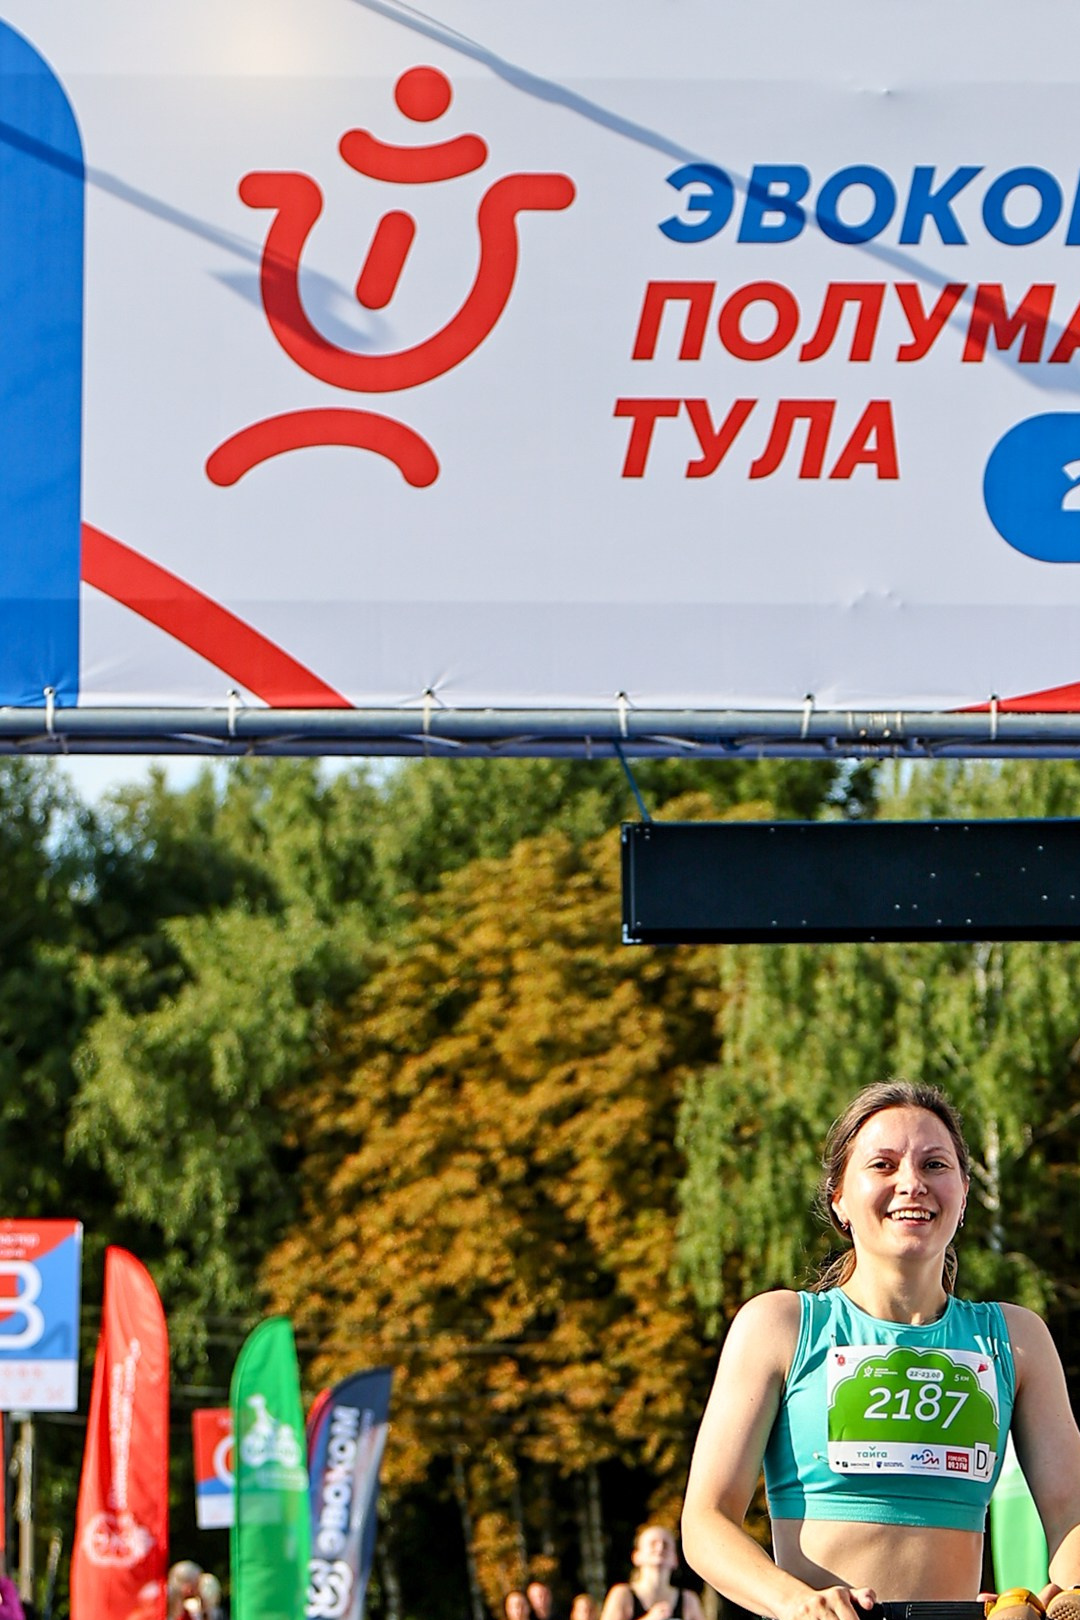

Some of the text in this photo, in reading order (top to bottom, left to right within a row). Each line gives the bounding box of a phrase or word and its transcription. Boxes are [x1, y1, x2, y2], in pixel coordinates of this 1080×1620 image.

[613, 398, 901, 480] ТУЛА
[954, 1373, 960, 1382] 5
[863, 1383, 970, 1429] 2187
[857, 1445, 888, 1458] тайга
[976, 1449, 988, 1470] D
